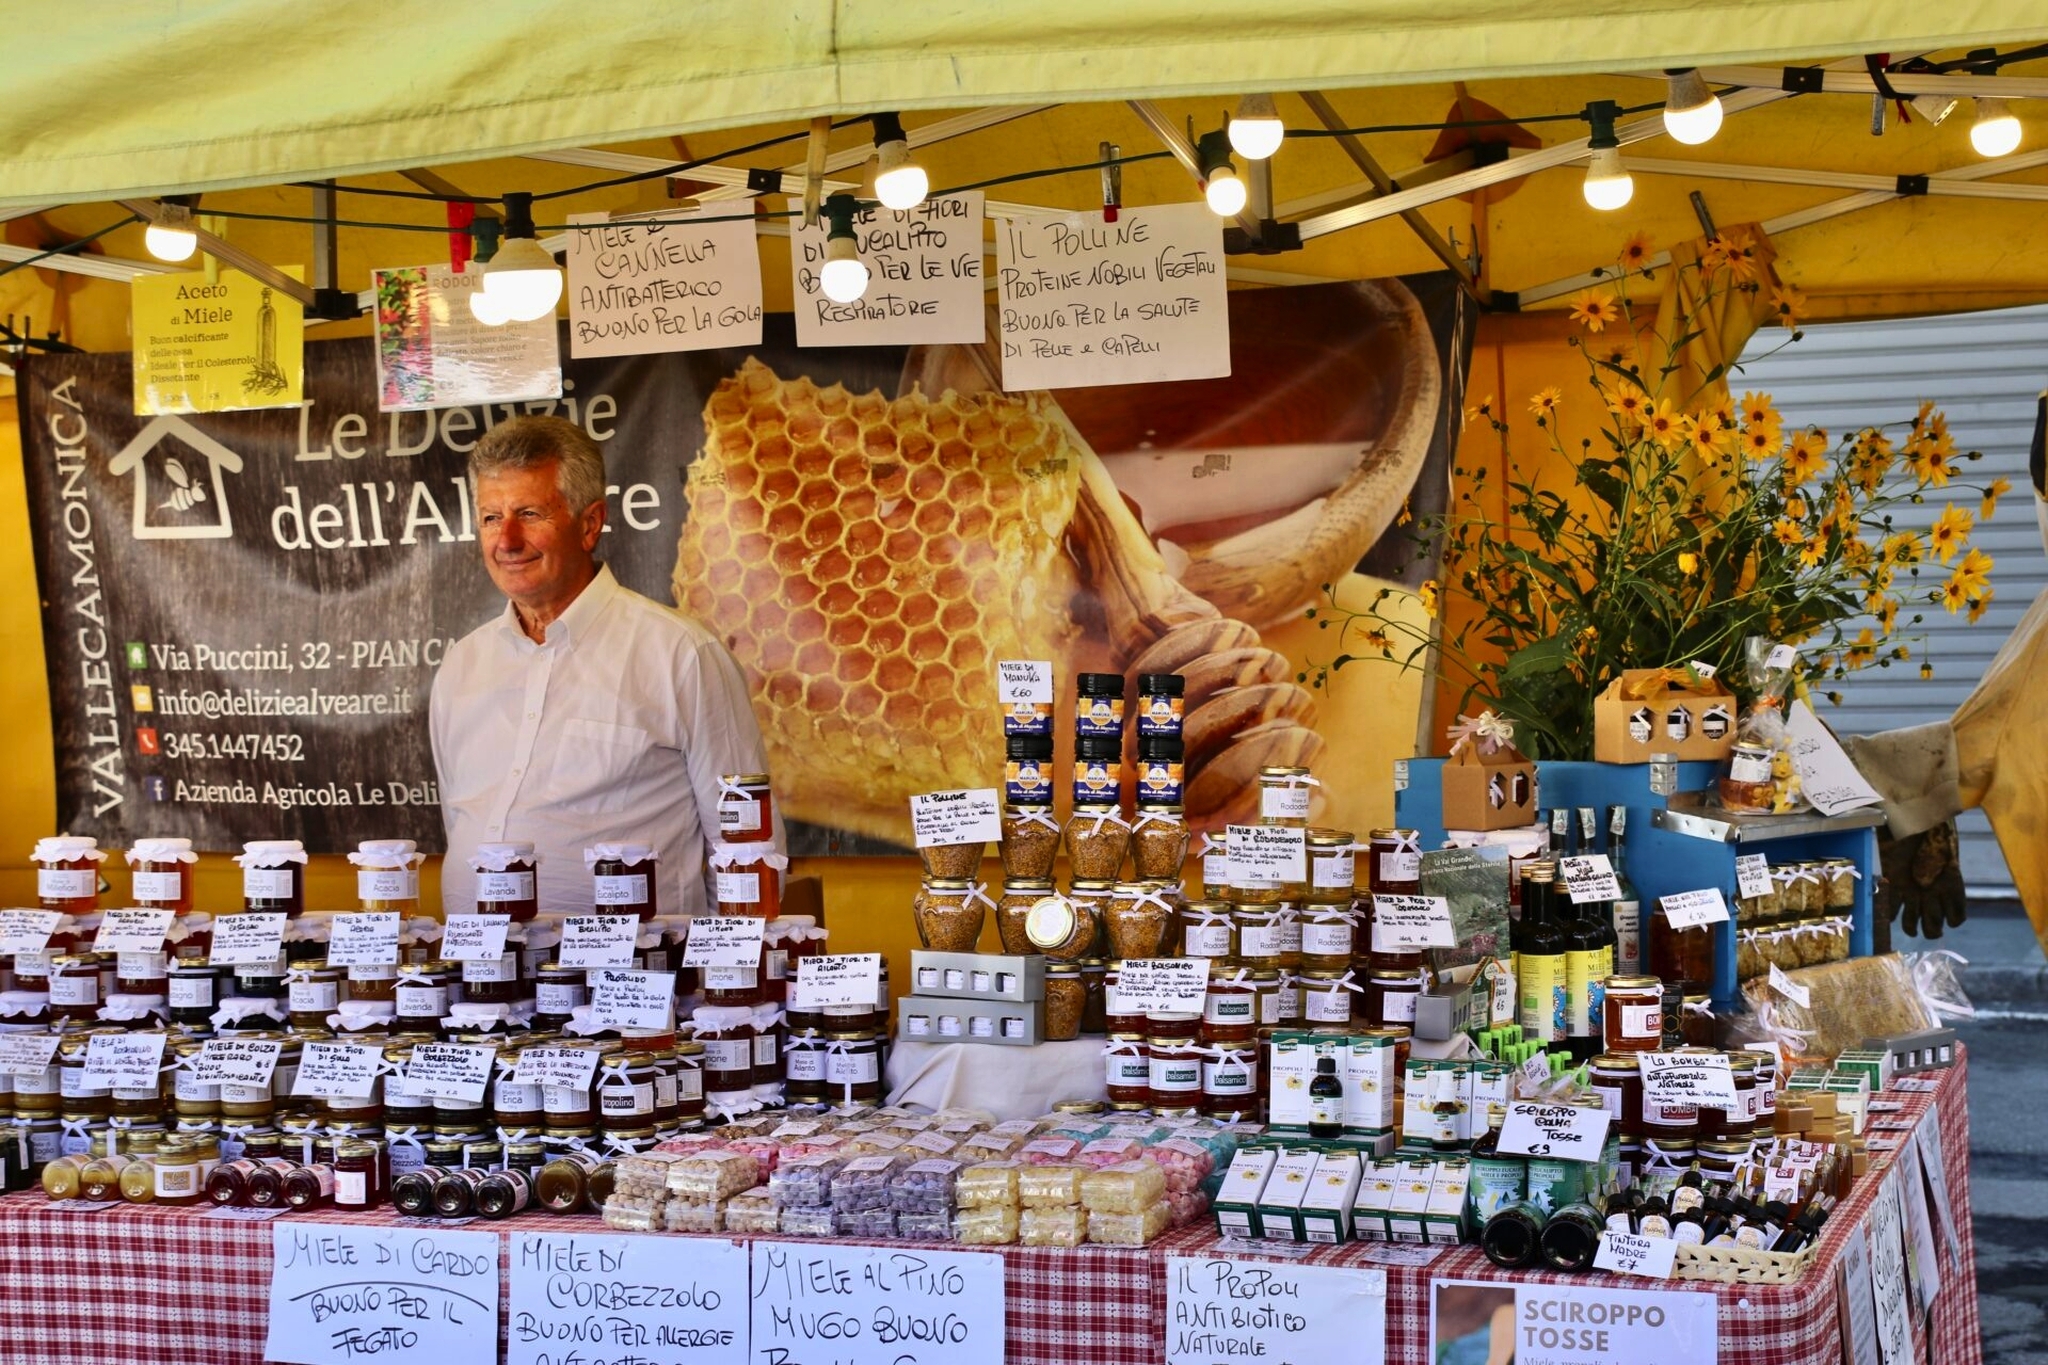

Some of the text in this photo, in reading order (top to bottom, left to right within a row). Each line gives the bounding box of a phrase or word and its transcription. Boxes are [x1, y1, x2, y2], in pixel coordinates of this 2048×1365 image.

[917, 199, 968, 222] FIORI
[804, 242, 824, 262] DI
[1008, 217, 1150, 264] IL POLLINE
[595, 237, 716, 279] CANNELLA
[874, 254, 912, 280] PER
[921, 254, 944, 280] LE
[951, 252, 980, 278] VIE
[1001, 245, 1216, 300] PROTEINE NOBILI VEGETALI
[176, 284, 228, 300] Aceto
[171, 307, 233, 325] di Miele
[816, 293, 939, 327] RESPIRATORIE
[1002, 298, 1201, 333] BUONO PER LA SALUTE
[577, 306, 761, 344] BUONO PER LA GOLA
[1005, 342, 1022, 358] DI
[1030, 338, 1074, 359] PELLE
[1102, 334, 1160, 357] CAPELLI
[206, 356, 257, 368] Colesterolo
[294, 379, 618, 463] Le Deie
[50, 375, 126, 817] VALLECAMONICA
[151, 644, 191, 671] Via
[194, 643, 294, 674] Puccini,
[300, 642, 331, 670] 32
[352, 638, 419, 669] PIAN
[1003, 672, 1041, 684] MANUKA
[158, 687, 412, 720] info@deliziealveare.it
[1010, 686, 1032, 698] €60
[164, 733, 305, 762] 345.1447452
[174, 778, 441, 810] Azienda Agricola Le Deli
[921, 796, 929, 804] IL
[373, 884, 400, 892] Acacia
[484, 888, 516, 896] Lavanda
[466, 966, 496, 976] Lavanda
[707, 972, 735, 982] Limone
[1126, 961, 1149, 969] MIELE
[401, 1002, 433, 1011] Lavanda
[1218, 1001, 1250, 1014] balsamico
[93, 1038, 116, 1048] MIELE
[207, 1042, 234, 1052] MIELE
[247, 1043, 276, 1053] COLZA
[523, 1049, 545, 1059] MIELE
[794, 1064, 816, 1073] Ailanto
[1214, 1073, 1247, 1085] balsamico
[224, 1086, 246, 1097] Colza
[502, 1096, 523, 1104] Erica
[1542, 1129, 1583, 1142] TOSSE
[1527, 1143, 1551, 1154] €9
[284, 1229, 490, 1276] MIELE DI CARDO
[1606, 1233, 1652, 1249] TINTURA
[1610, 1244, 1647, 1260] MADRE
[522, 1237, 624, 1273] MIELE DI
[1617, 1258, 1639, 1271] €7
[754, 1250, 965, 1300] MIELE AL PINO
[1178, 1265, 1198, 1295] IL
[547, 1272, 721, 1310] CORBEZZOLO
[311, 1286, 464, 1325] BUONO PER IL
[1176, 1301, 1306, 1332] ANTIBIOTICO
[1524, 1299, 1665, 1328] SCIROPPO
[516, 1312, 735, 1348] BUONO PER ALLERGIE
[771, 1304, 968, 1345] MUGO BUONO
[332, 1327, 418, 1359] FEGATO
[1171, 1330, 1267, 1357] NATURALE
[1523, 1326, 1609, 1352] TOSSE
